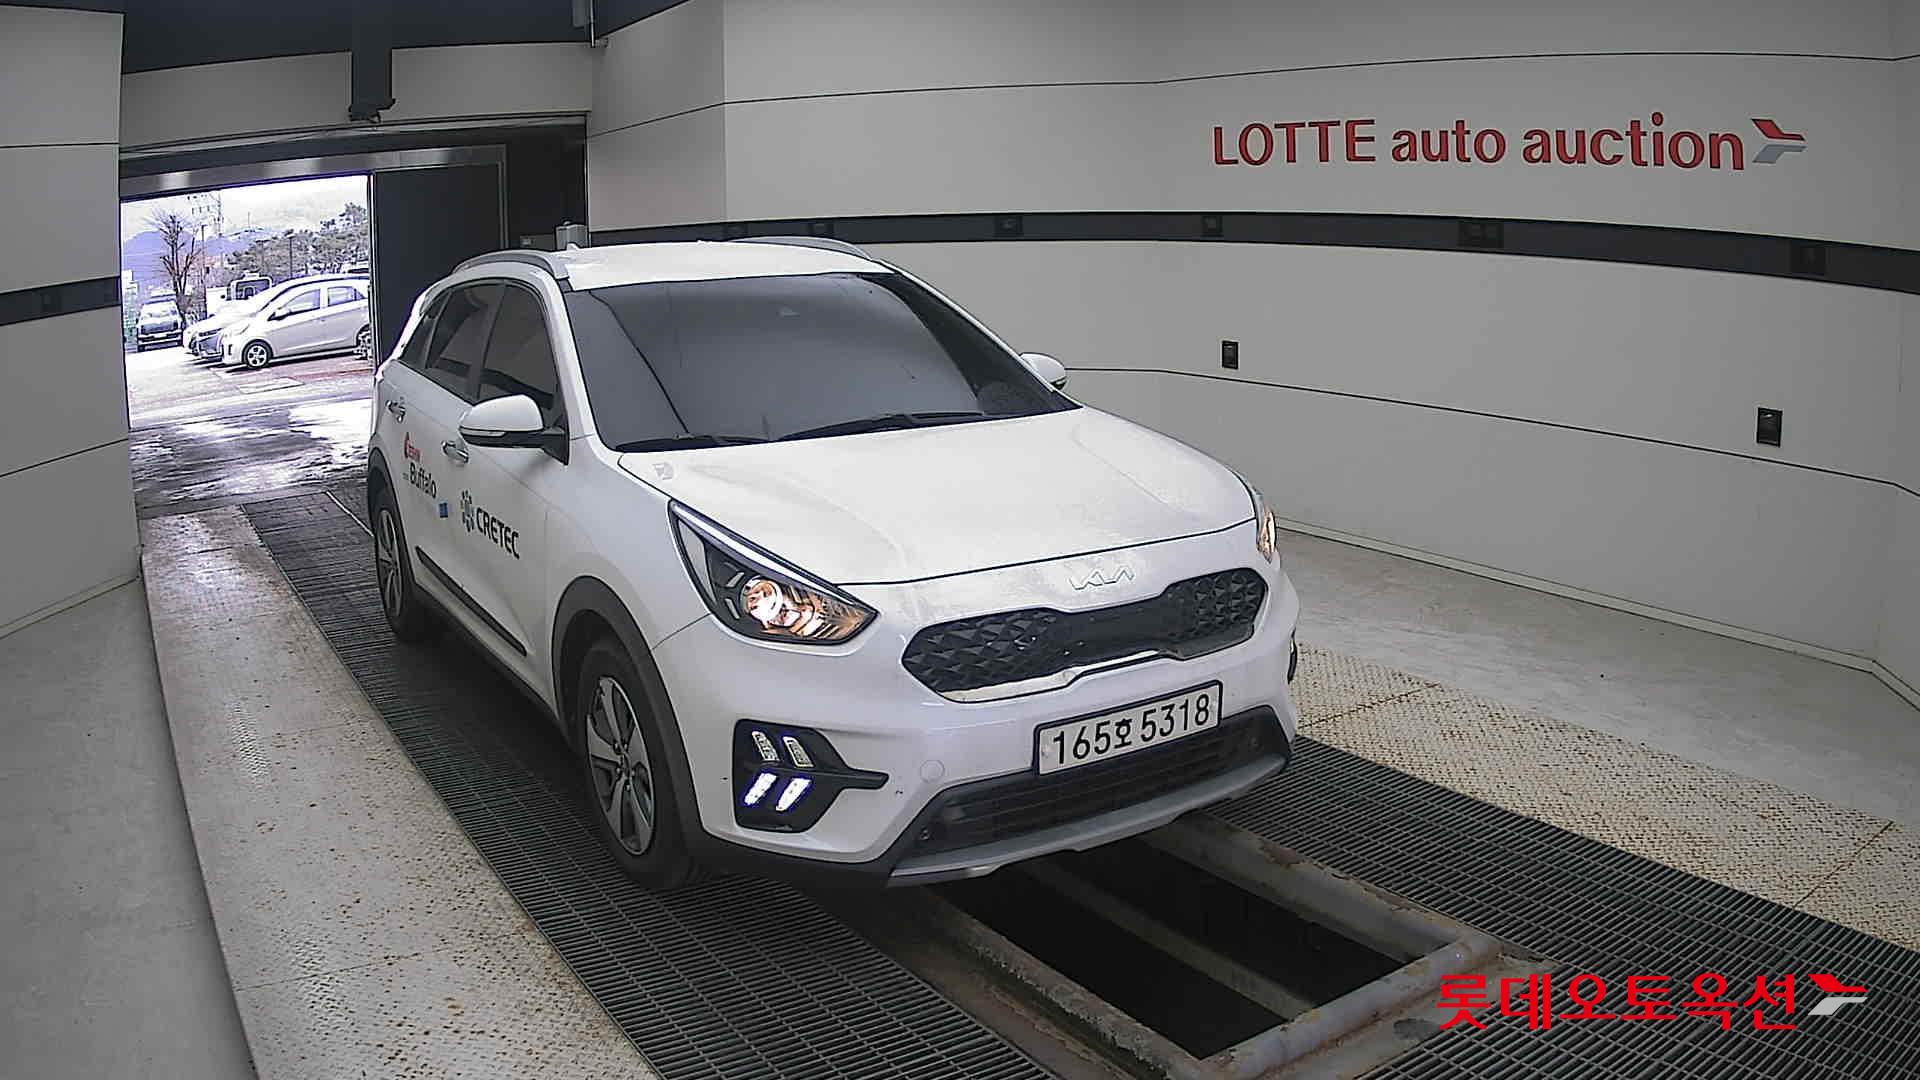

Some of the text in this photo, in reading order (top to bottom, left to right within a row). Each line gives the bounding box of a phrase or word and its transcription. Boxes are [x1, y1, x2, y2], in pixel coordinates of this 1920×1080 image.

[1213, 111, 1745, 171] LOTTE auto auction
[475, 507, 520, 560] CRETEC
[1140, 693, 1210, 743] 5318
